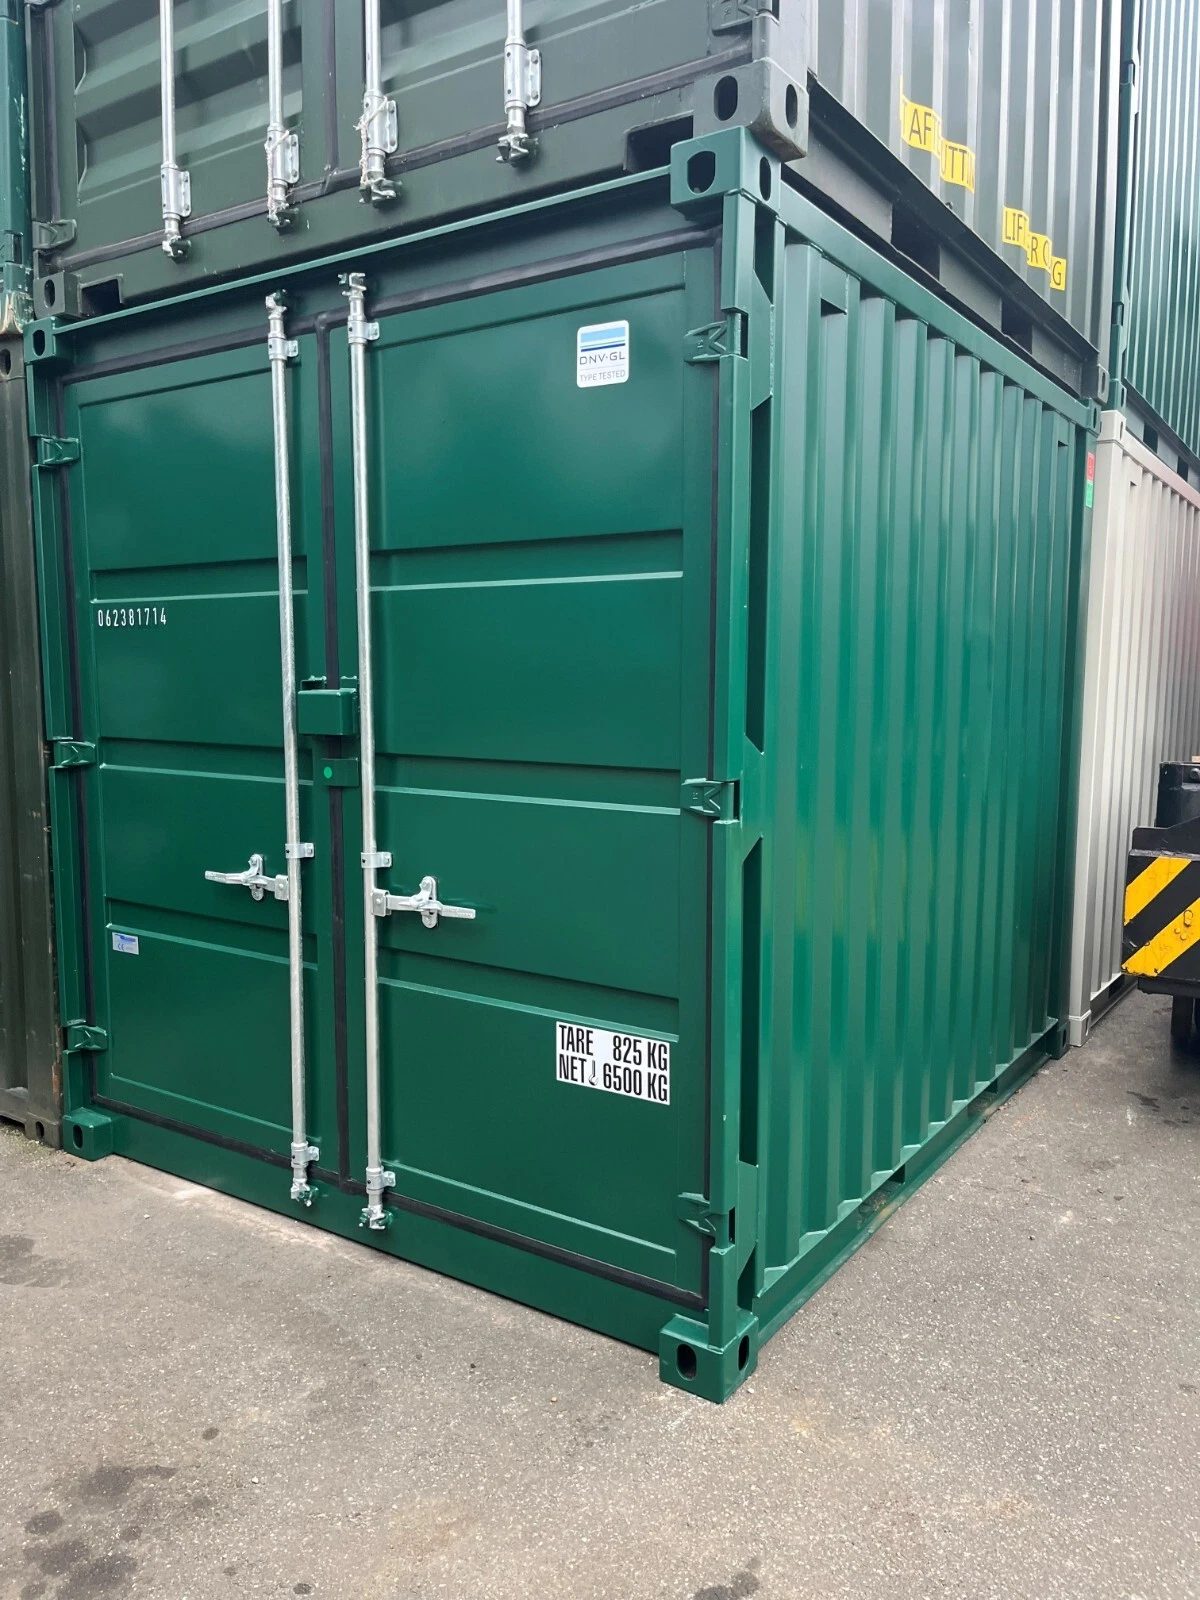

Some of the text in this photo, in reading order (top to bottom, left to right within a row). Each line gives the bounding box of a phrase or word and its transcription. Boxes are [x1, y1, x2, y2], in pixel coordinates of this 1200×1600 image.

[580, 369, 626, 382] TYPE TESTED
[97, 607, 167, 627] 062381714
[559, 1024, 668, 1071] TARE 825 KG
[559, 1053, 668, 1102] NET 6500 KG
